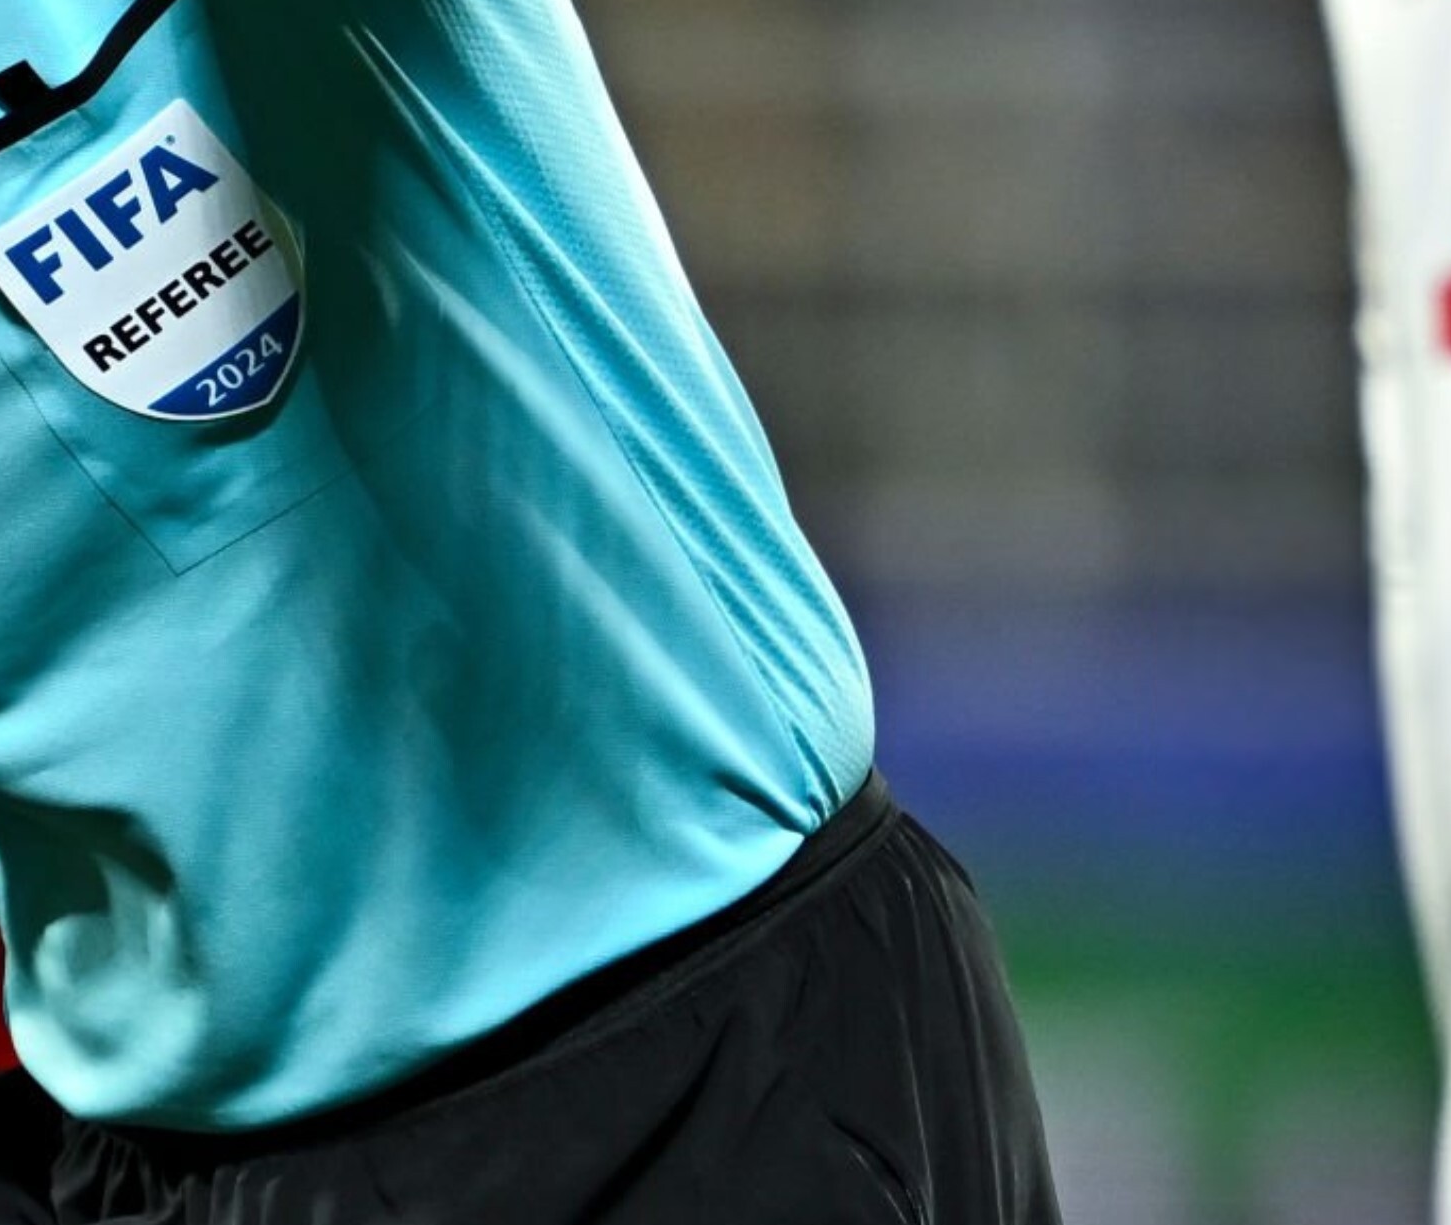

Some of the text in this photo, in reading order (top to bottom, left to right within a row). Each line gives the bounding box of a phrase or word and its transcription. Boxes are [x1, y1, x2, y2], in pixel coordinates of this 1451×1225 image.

[6, 144, 219, 305] FIFA
[83, 220, 273, 372] REFEREE
[196, 332, 283, 406] 2024
